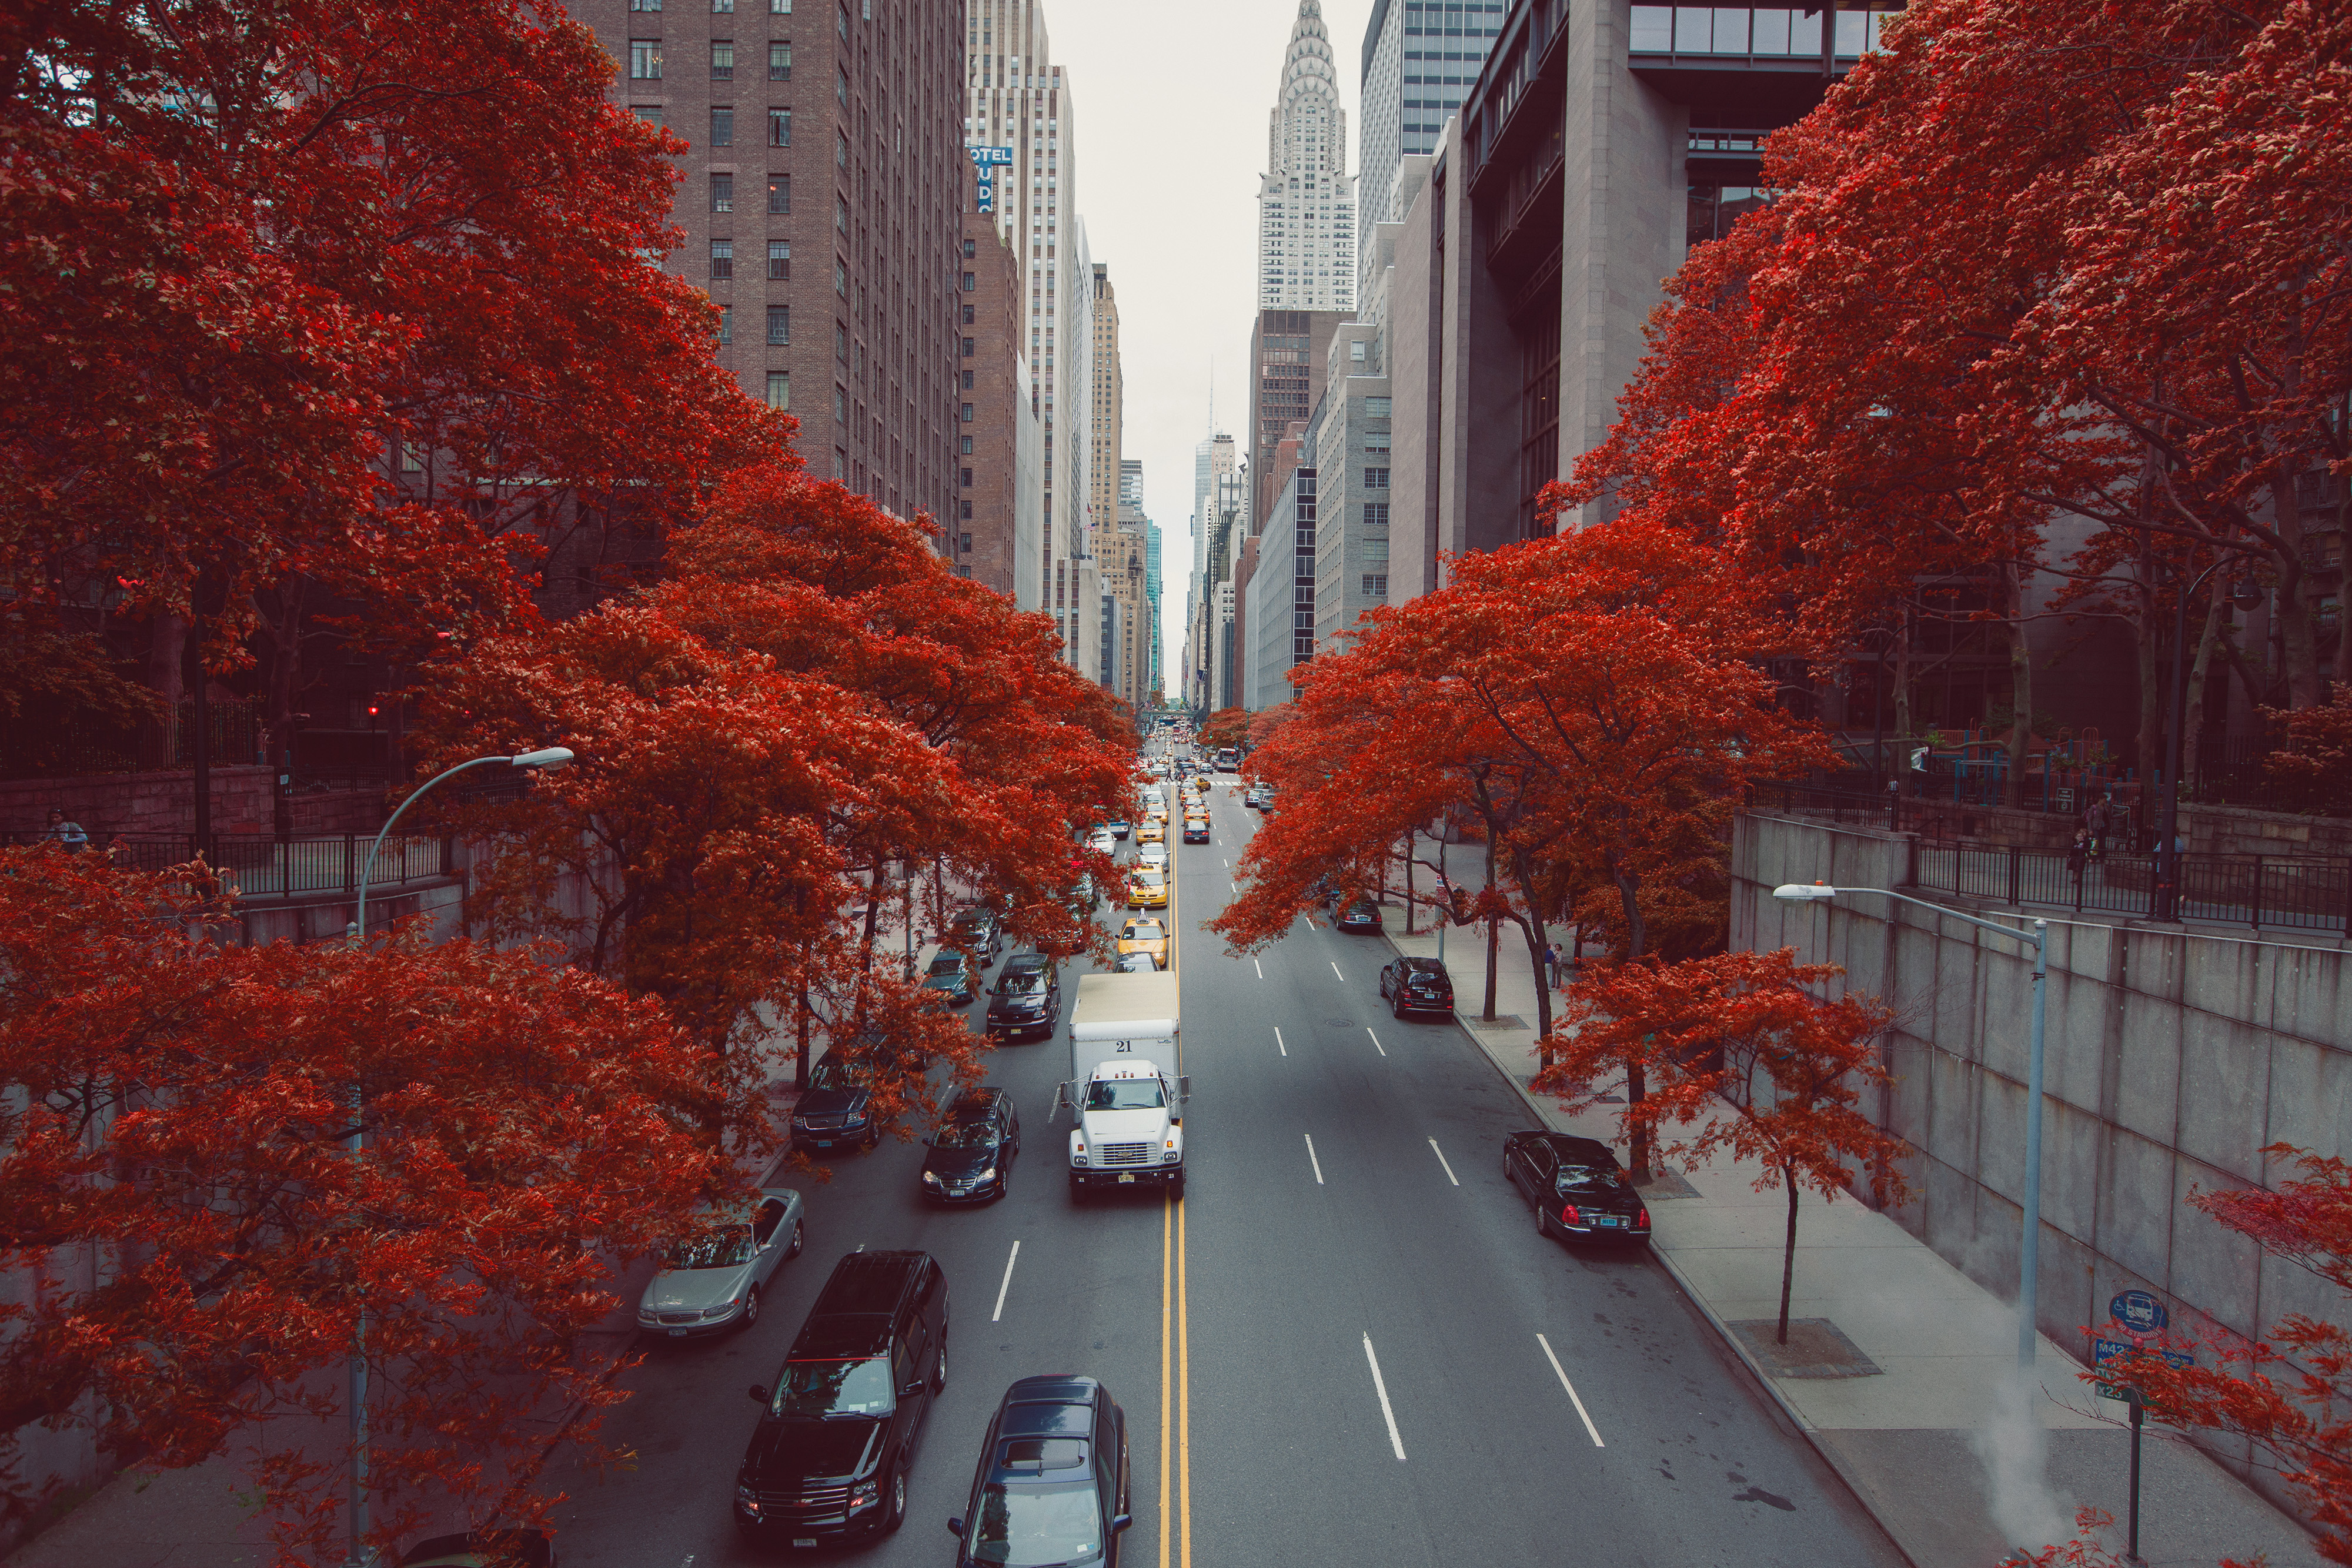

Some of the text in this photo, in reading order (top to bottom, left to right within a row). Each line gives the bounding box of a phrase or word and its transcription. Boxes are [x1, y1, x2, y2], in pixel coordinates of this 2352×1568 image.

[1116, 1040, 1132, 1052] 21
[2118, 1323, 2162, 1338] NO STANDING
[2099, 1343, 2124, 1355] M42
